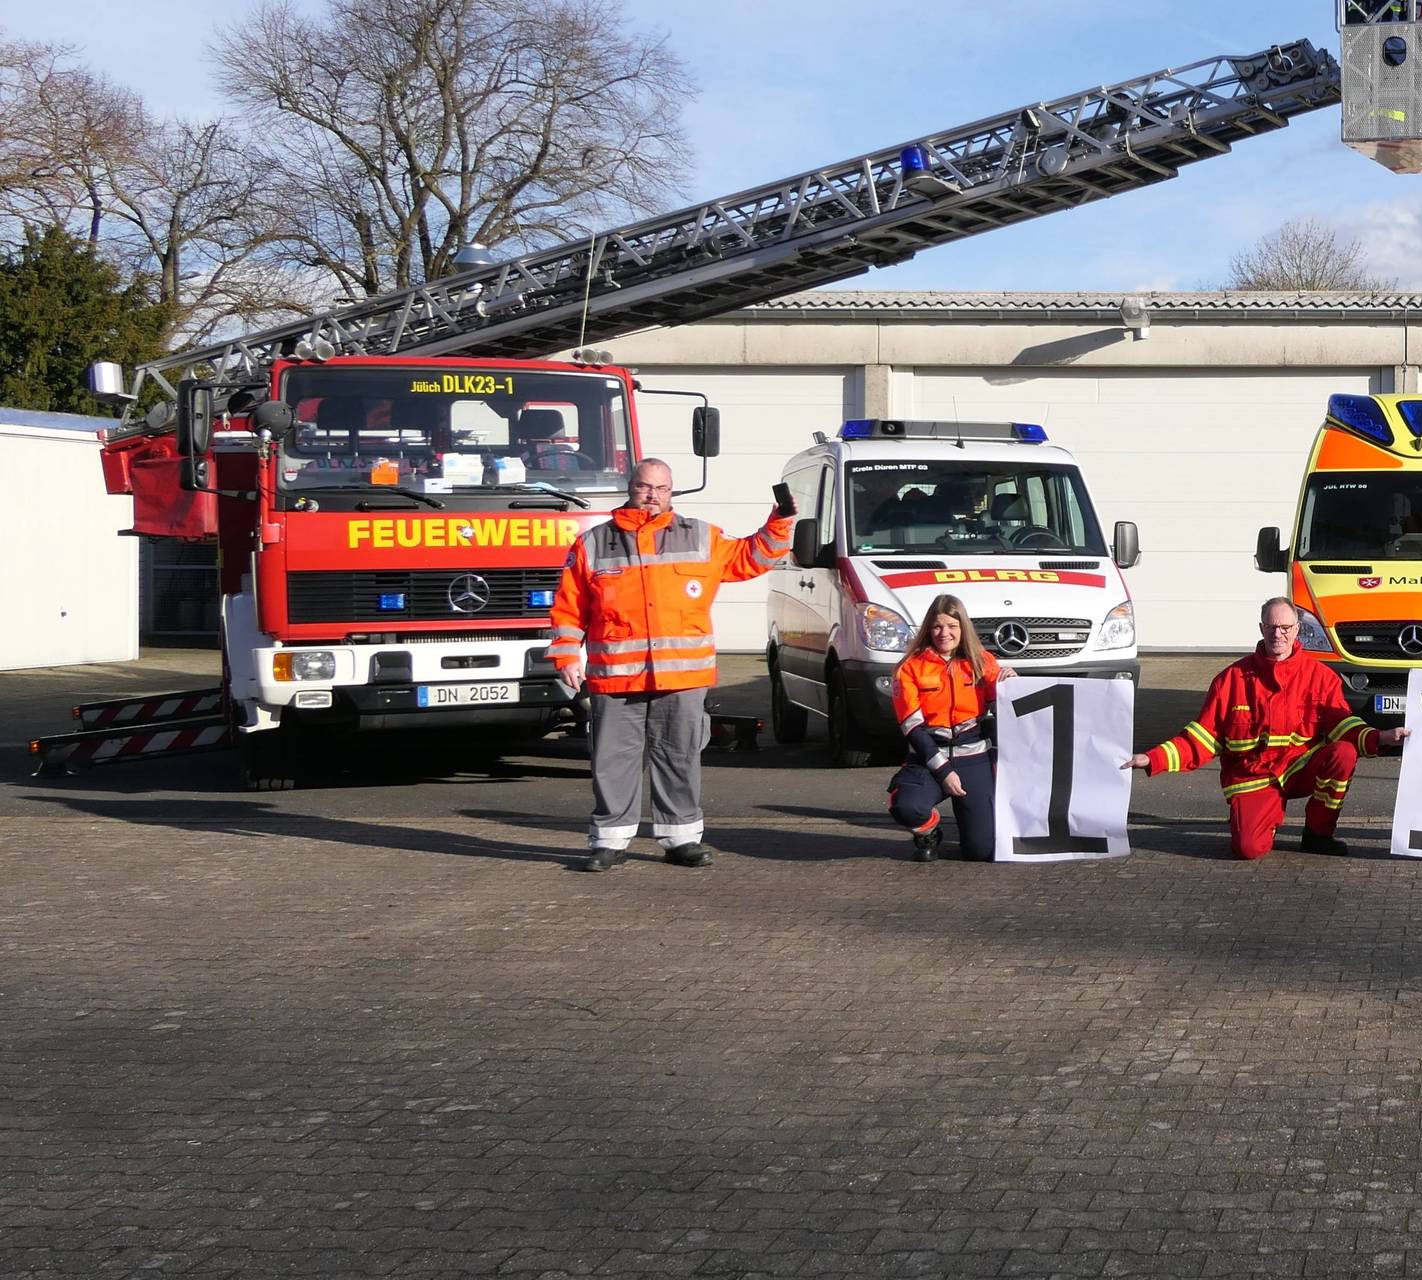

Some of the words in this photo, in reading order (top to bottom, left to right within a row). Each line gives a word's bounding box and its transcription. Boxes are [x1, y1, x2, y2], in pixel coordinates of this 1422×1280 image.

[410, 381, 441, 393] Jülich
[442, 375, 514, 395] DLK23-1
[349, 518, 580, 549] FEUERWEHR
[934, 570, 1060, 583] DLRG
[437, 688, 458, 703] DN
[470, 685, 509, 702] 2052
[1383, 697, 1400, 710] DN
[1011, 684, 1109, 855] 1
